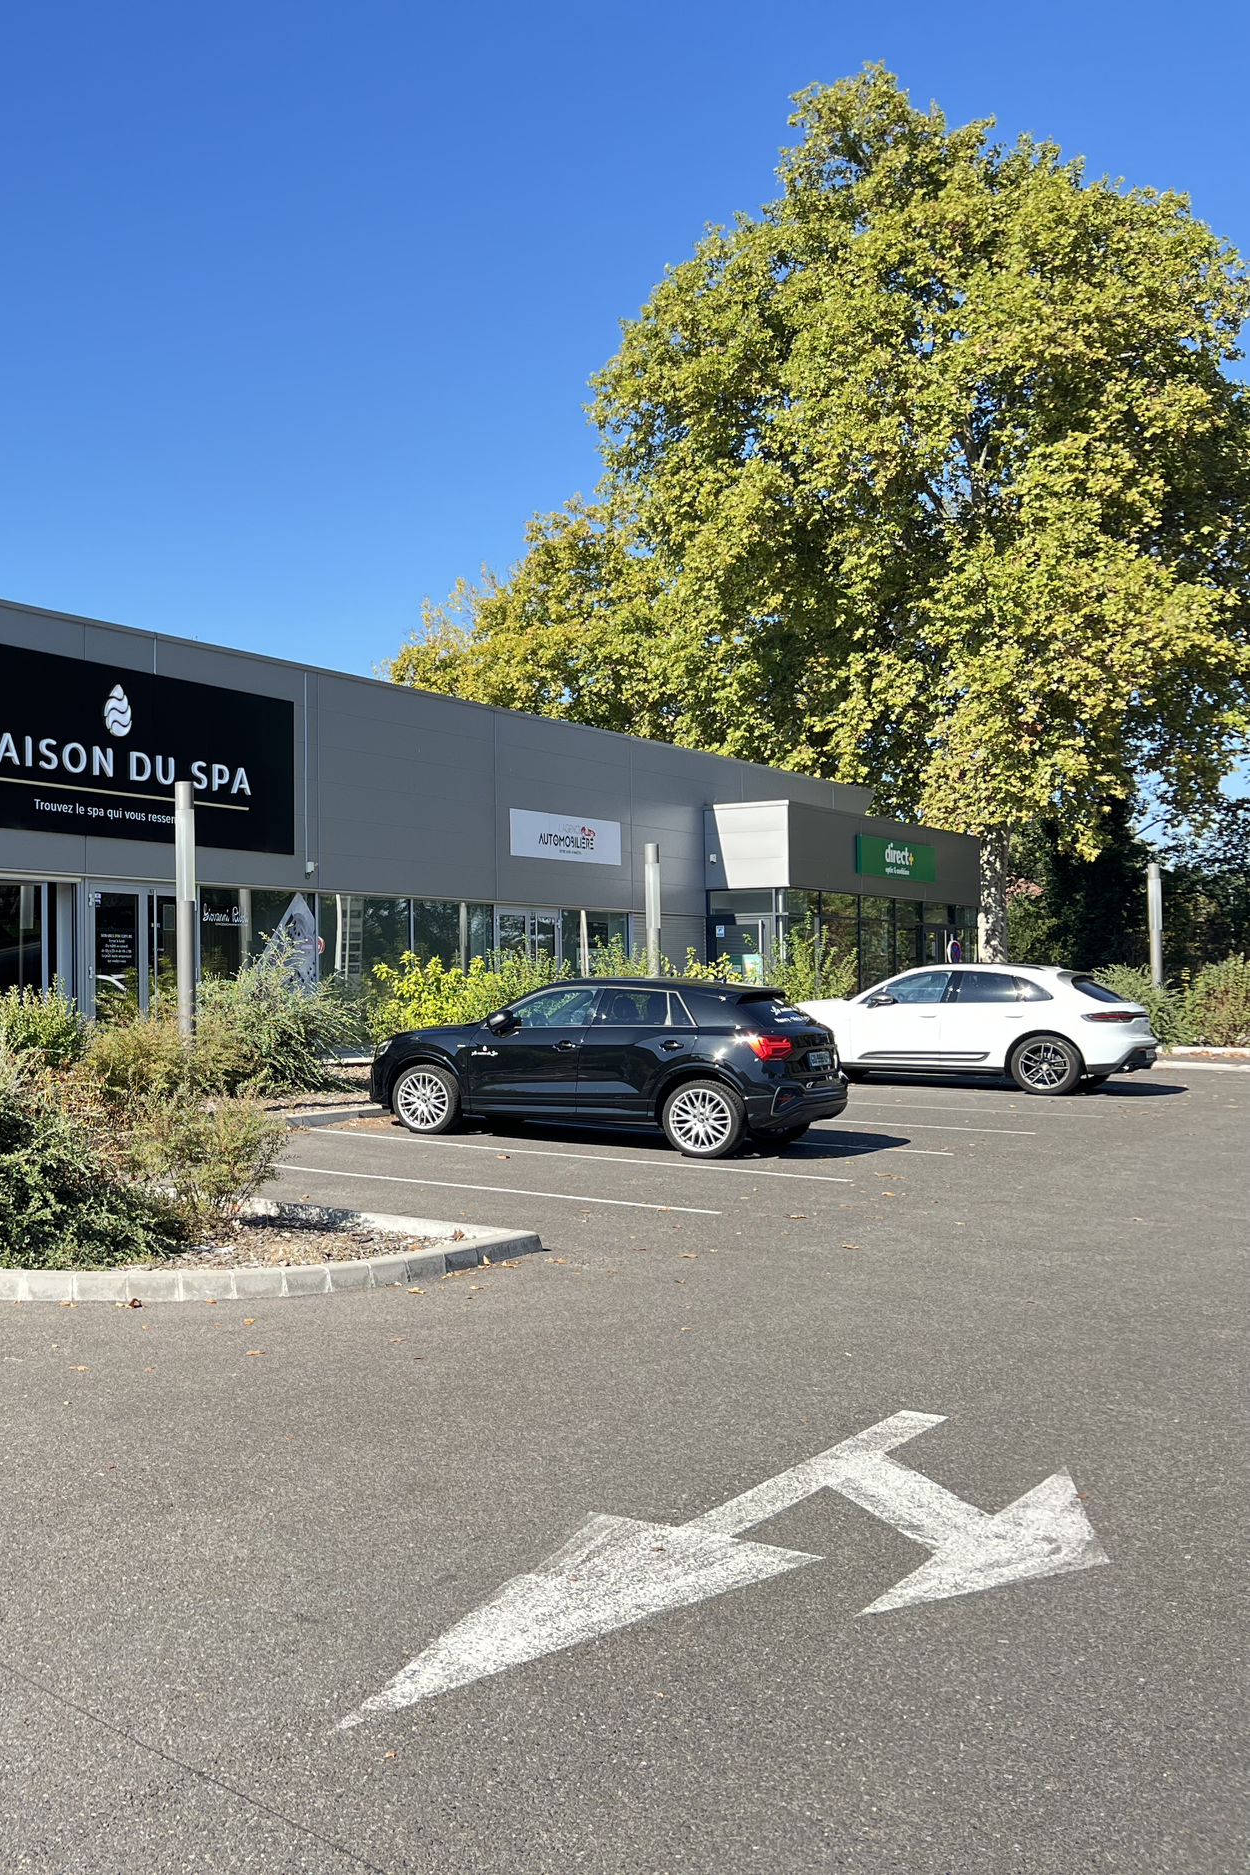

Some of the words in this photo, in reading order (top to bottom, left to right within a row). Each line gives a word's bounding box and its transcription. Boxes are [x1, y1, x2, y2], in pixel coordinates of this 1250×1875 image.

[129, 750, 176, 786] DU
[191, 761, 252, 796] SPA
[34, 798, 74, 814] Trouvez
[76, 803, 85, 815] le
[87, 806, 104, 818] spa
[107, 808, 122, 820] qui
[124, 810, 146, 821] vous
[148, 812, 176, 824] resse
